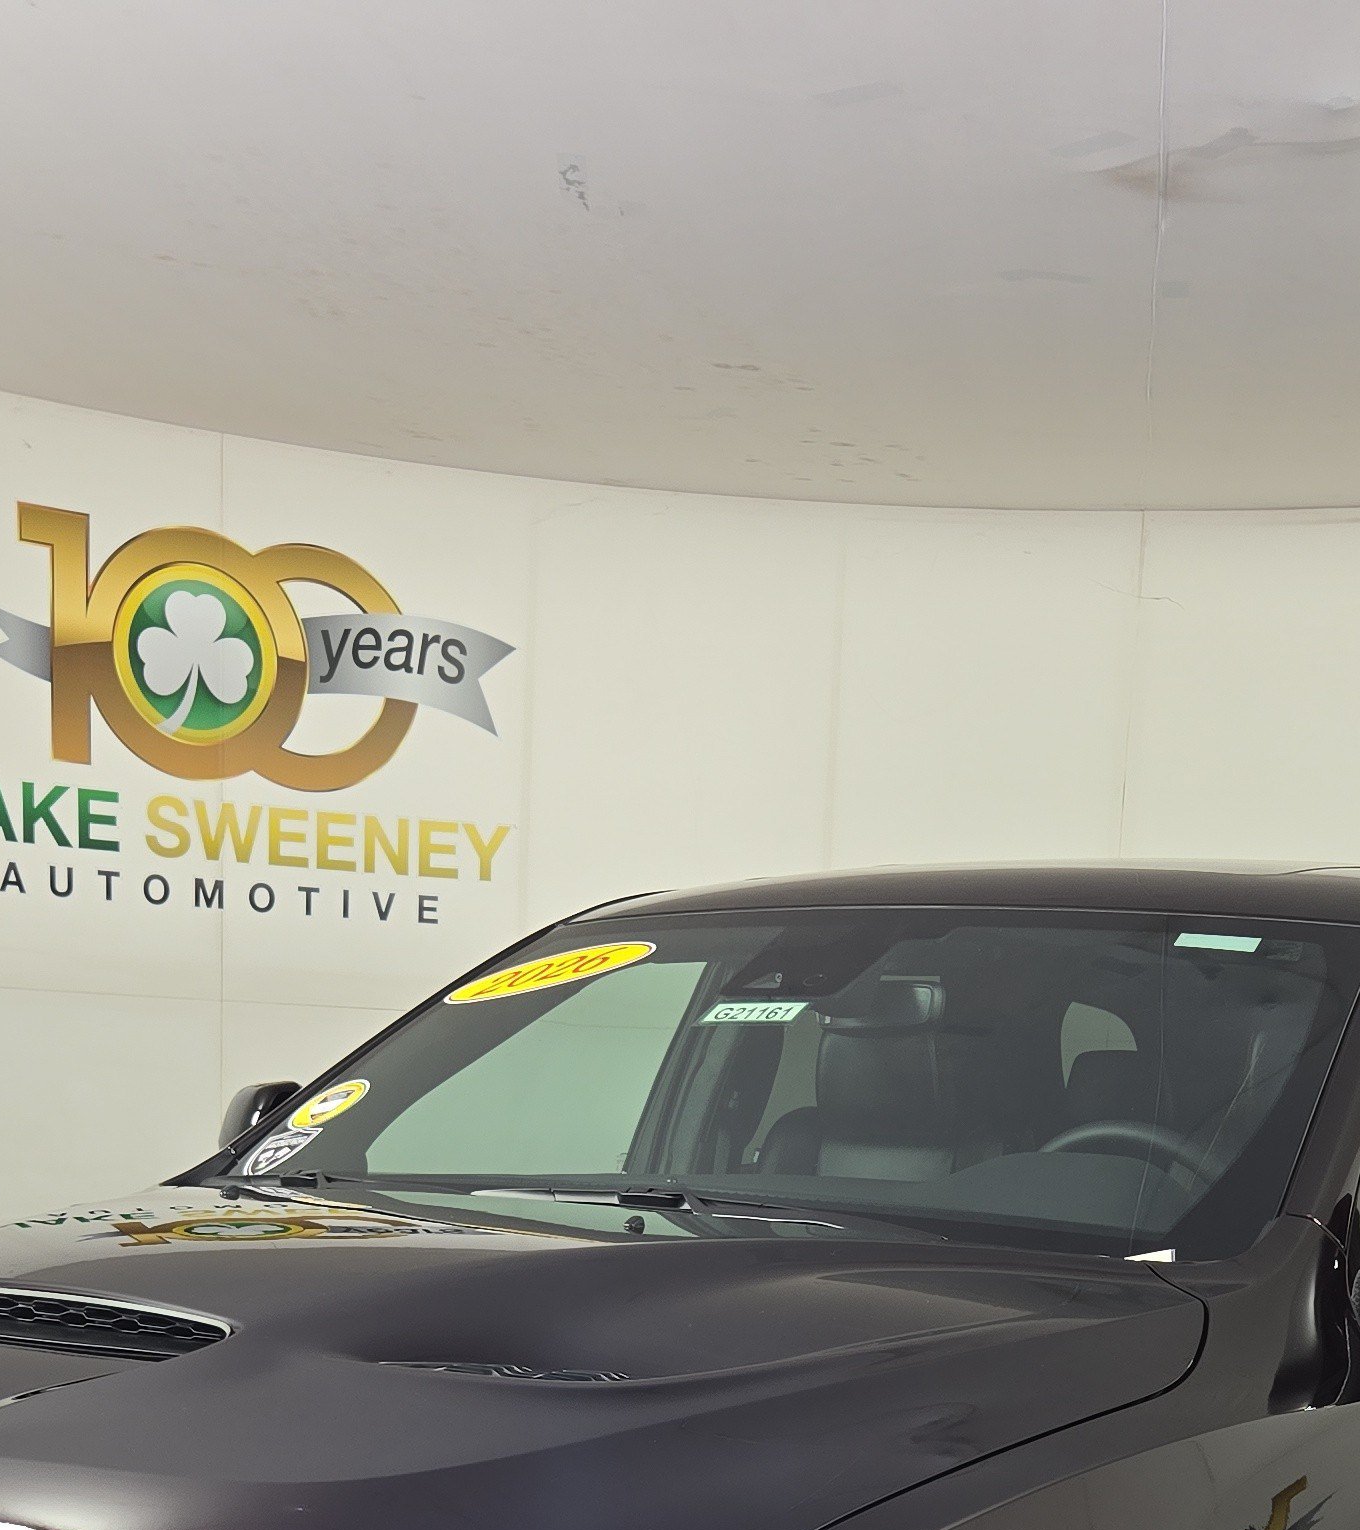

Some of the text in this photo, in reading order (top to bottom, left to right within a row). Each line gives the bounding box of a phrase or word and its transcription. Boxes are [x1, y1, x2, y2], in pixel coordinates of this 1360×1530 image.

[17, 501, 418, 792] 100
[319, 625, 468, 685] years
[145, 794, 511, 883] SWEENEY
[0, 861, 439, 925] AUTOMOTIVE
[470, 946, 629, 998] 2026
[714, 1006, 794, 1020] G21161
